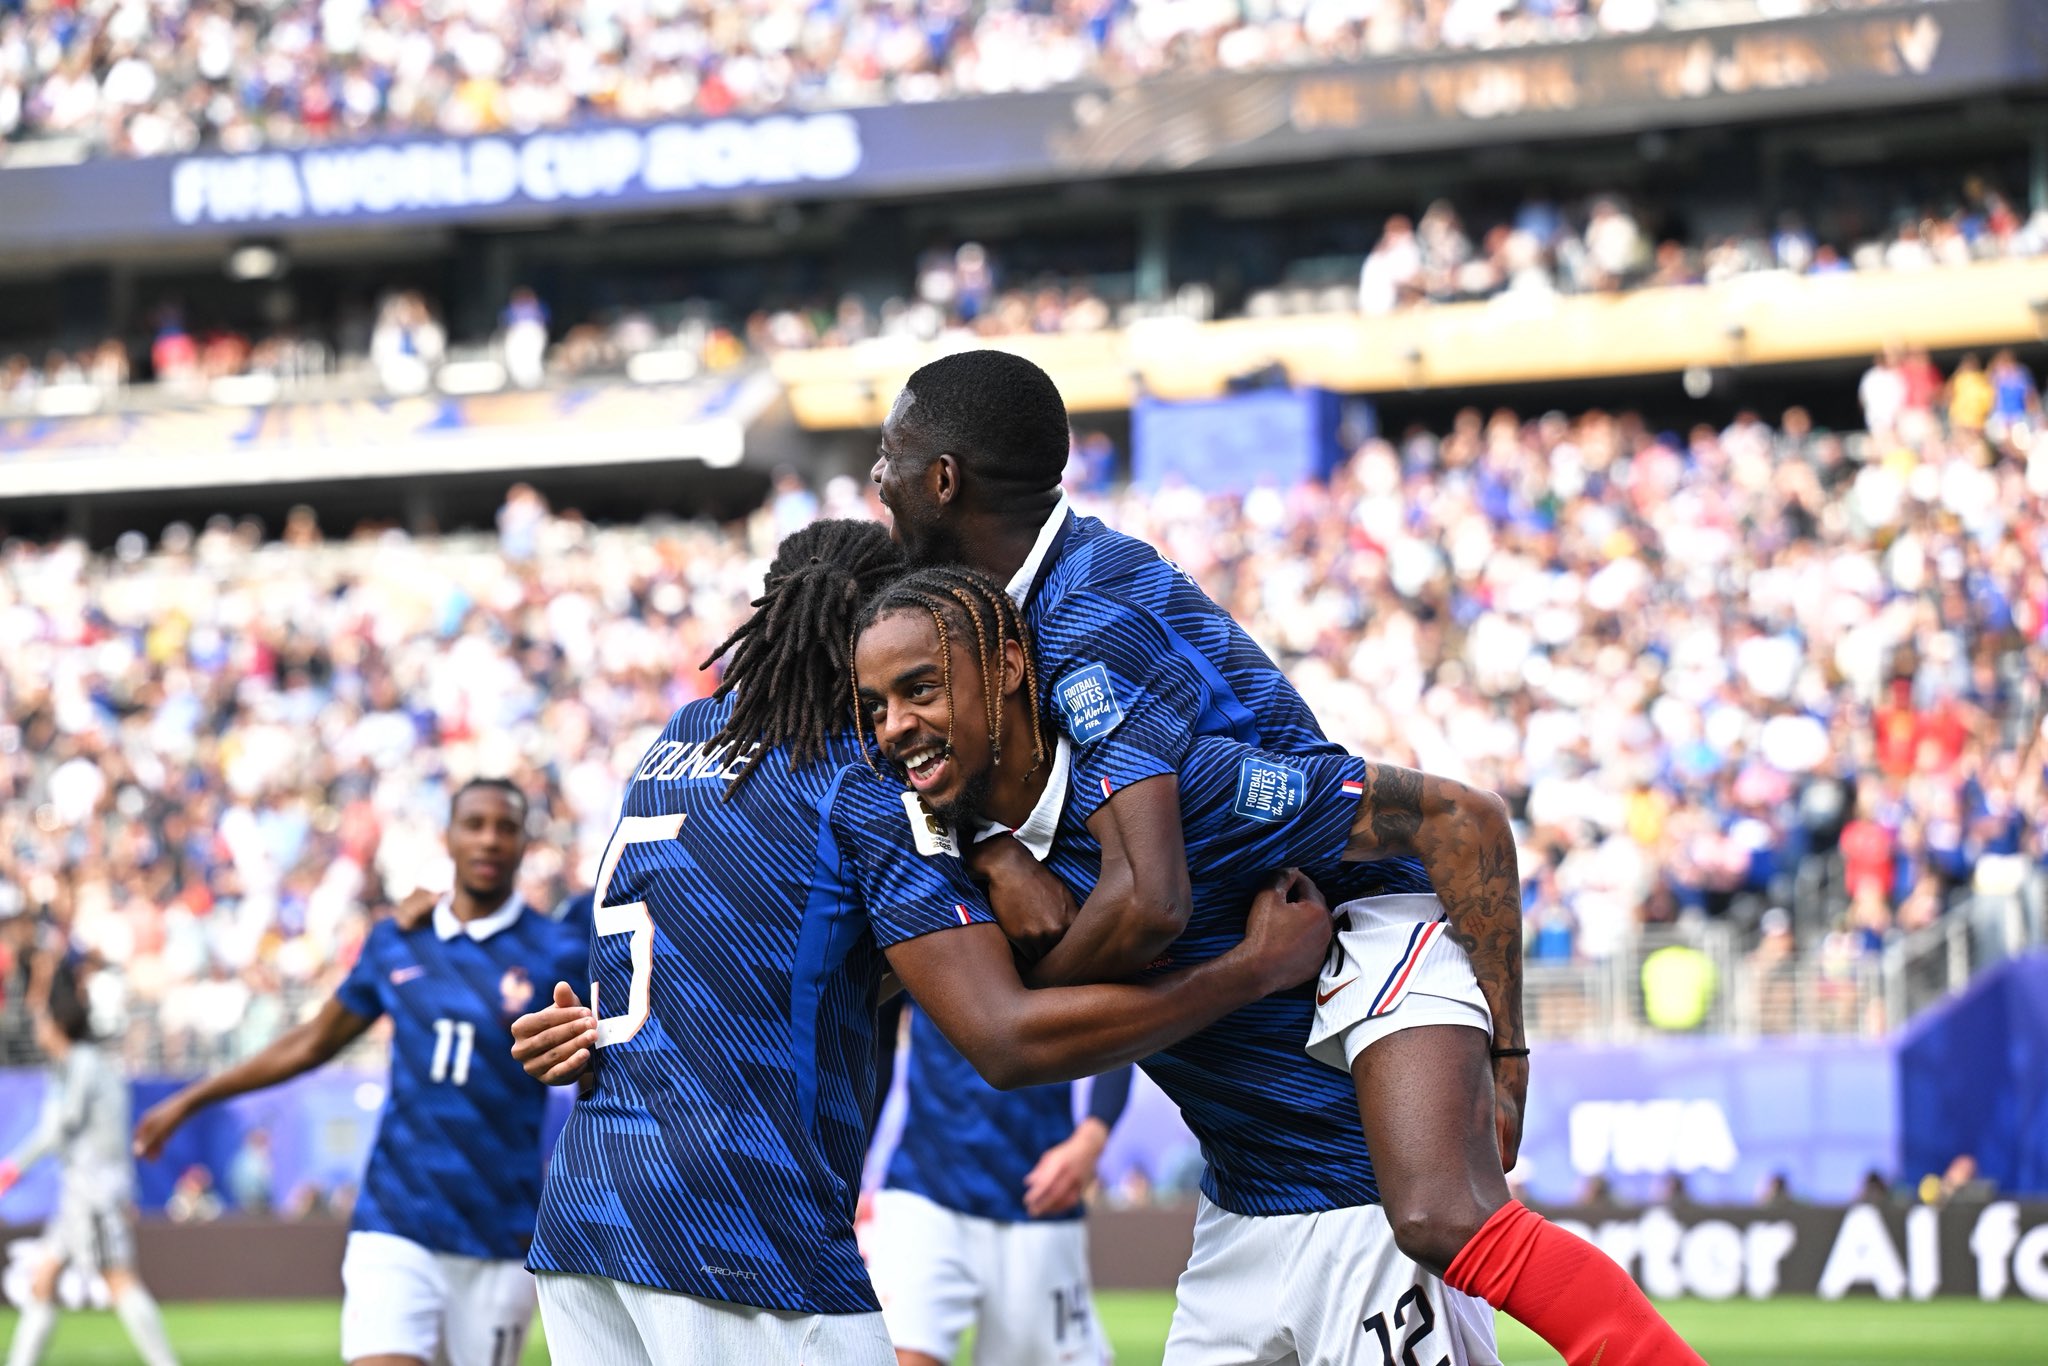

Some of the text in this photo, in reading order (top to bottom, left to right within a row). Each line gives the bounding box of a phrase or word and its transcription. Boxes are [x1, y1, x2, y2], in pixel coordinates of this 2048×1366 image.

[172, 113, 862, 224] FIFA WORLD CUP 2026
[1063, 676, 1100, 700] FOOTBALL
[1067, 686, 1104, 713] UNITES
[1074, 700, 1111, 727] the World
[1085, 719, 1101, 730] FIFA
[1245, 768, 1262, 808] FOOTBALL
[1256, 769, 1276, 811] UNITES
[1271, 771, 1289, 816] the World
[1287, 788, 1296, 805] FIFA
[590, 813, 687, 1049] 5
[430, 1018, 475, 1086] 11
[1570, 1099, 1738, 1175] FIFA
[700, 1265, 758, 1280] AERO-FIT
[1551, 1206, 1796, 1300] rter
[1817, 1203, 1942, 1301] AI
[1362, 1283, 1451, 1366] 12
